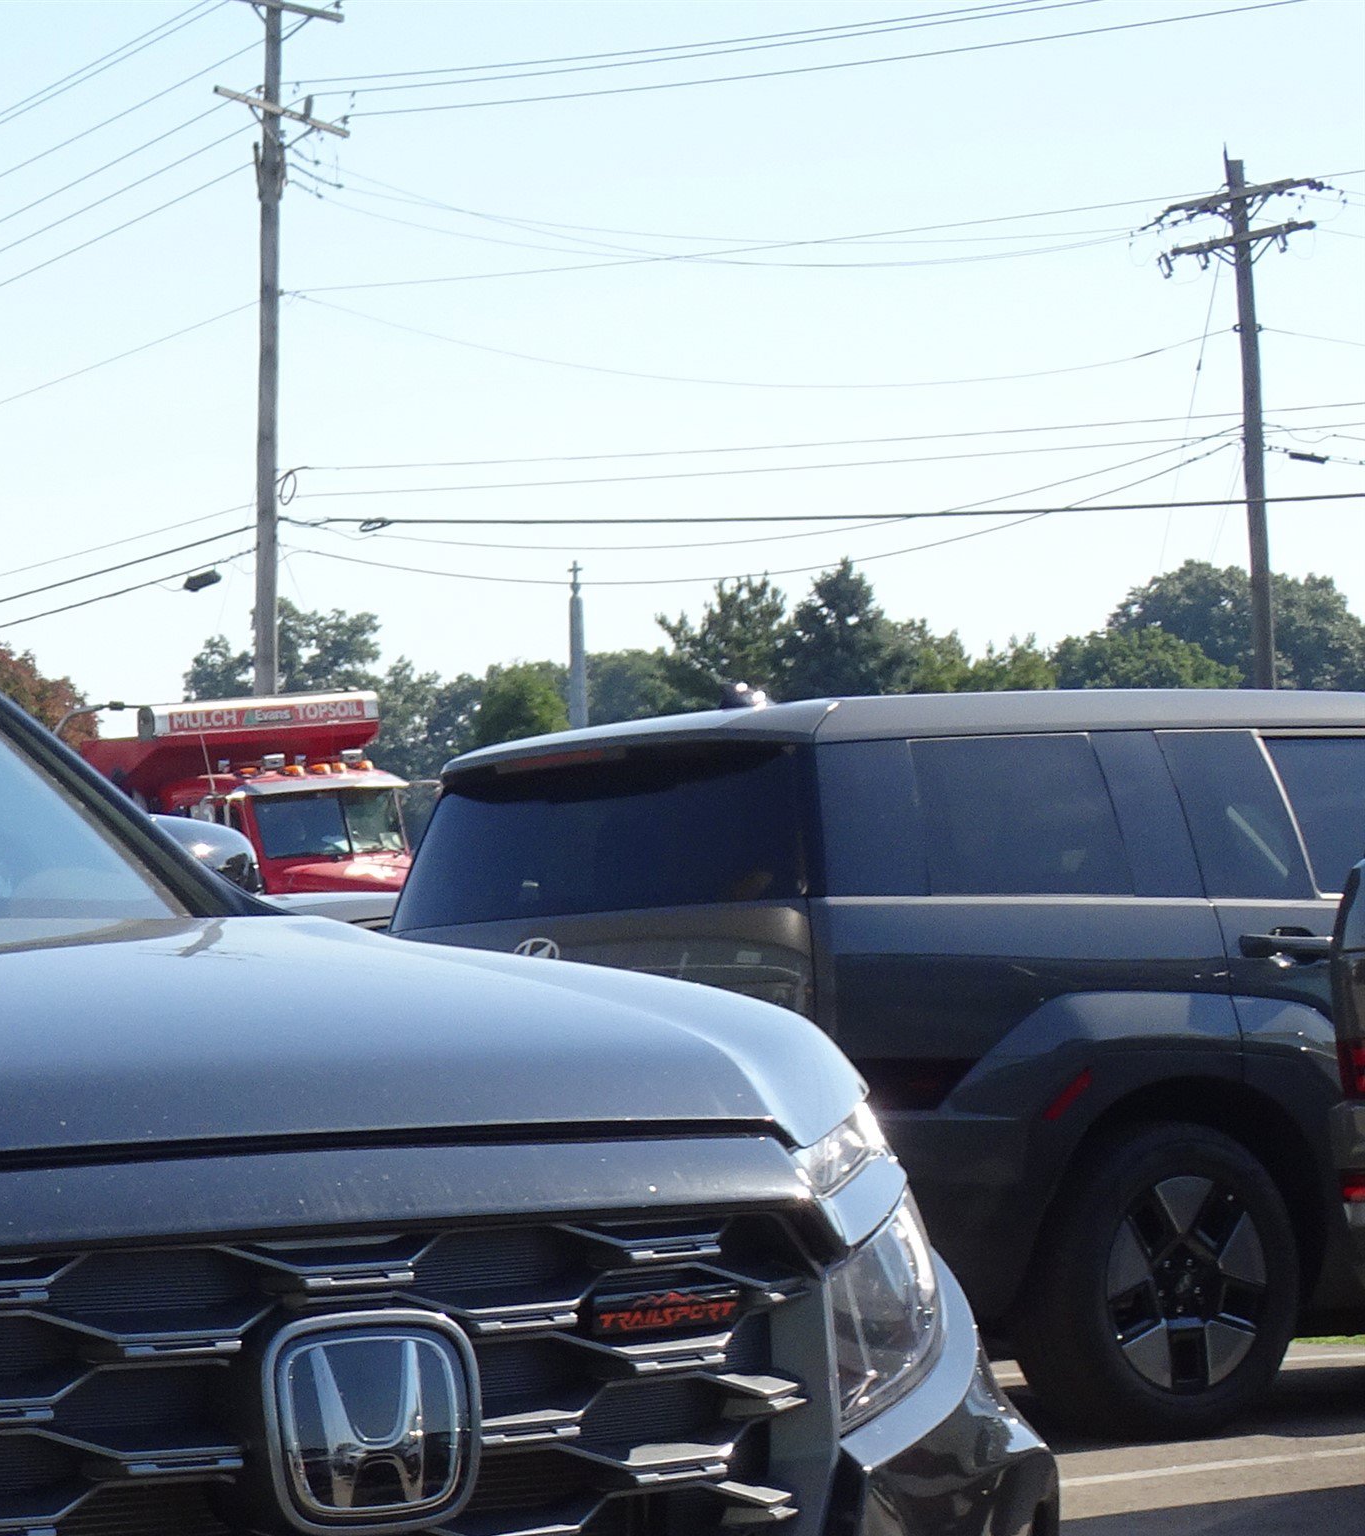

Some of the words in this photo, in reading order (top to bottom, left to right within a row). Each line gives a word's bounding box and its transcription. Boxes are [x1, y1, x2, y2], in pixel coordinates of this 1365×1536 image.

[172, 708, 237, 729] MULCH
[254, 708, 291, 723] Evans
[294, 701, 363, 721] TOPSOIL
[598, 1300, 738, 1331] TRAILSPORT
